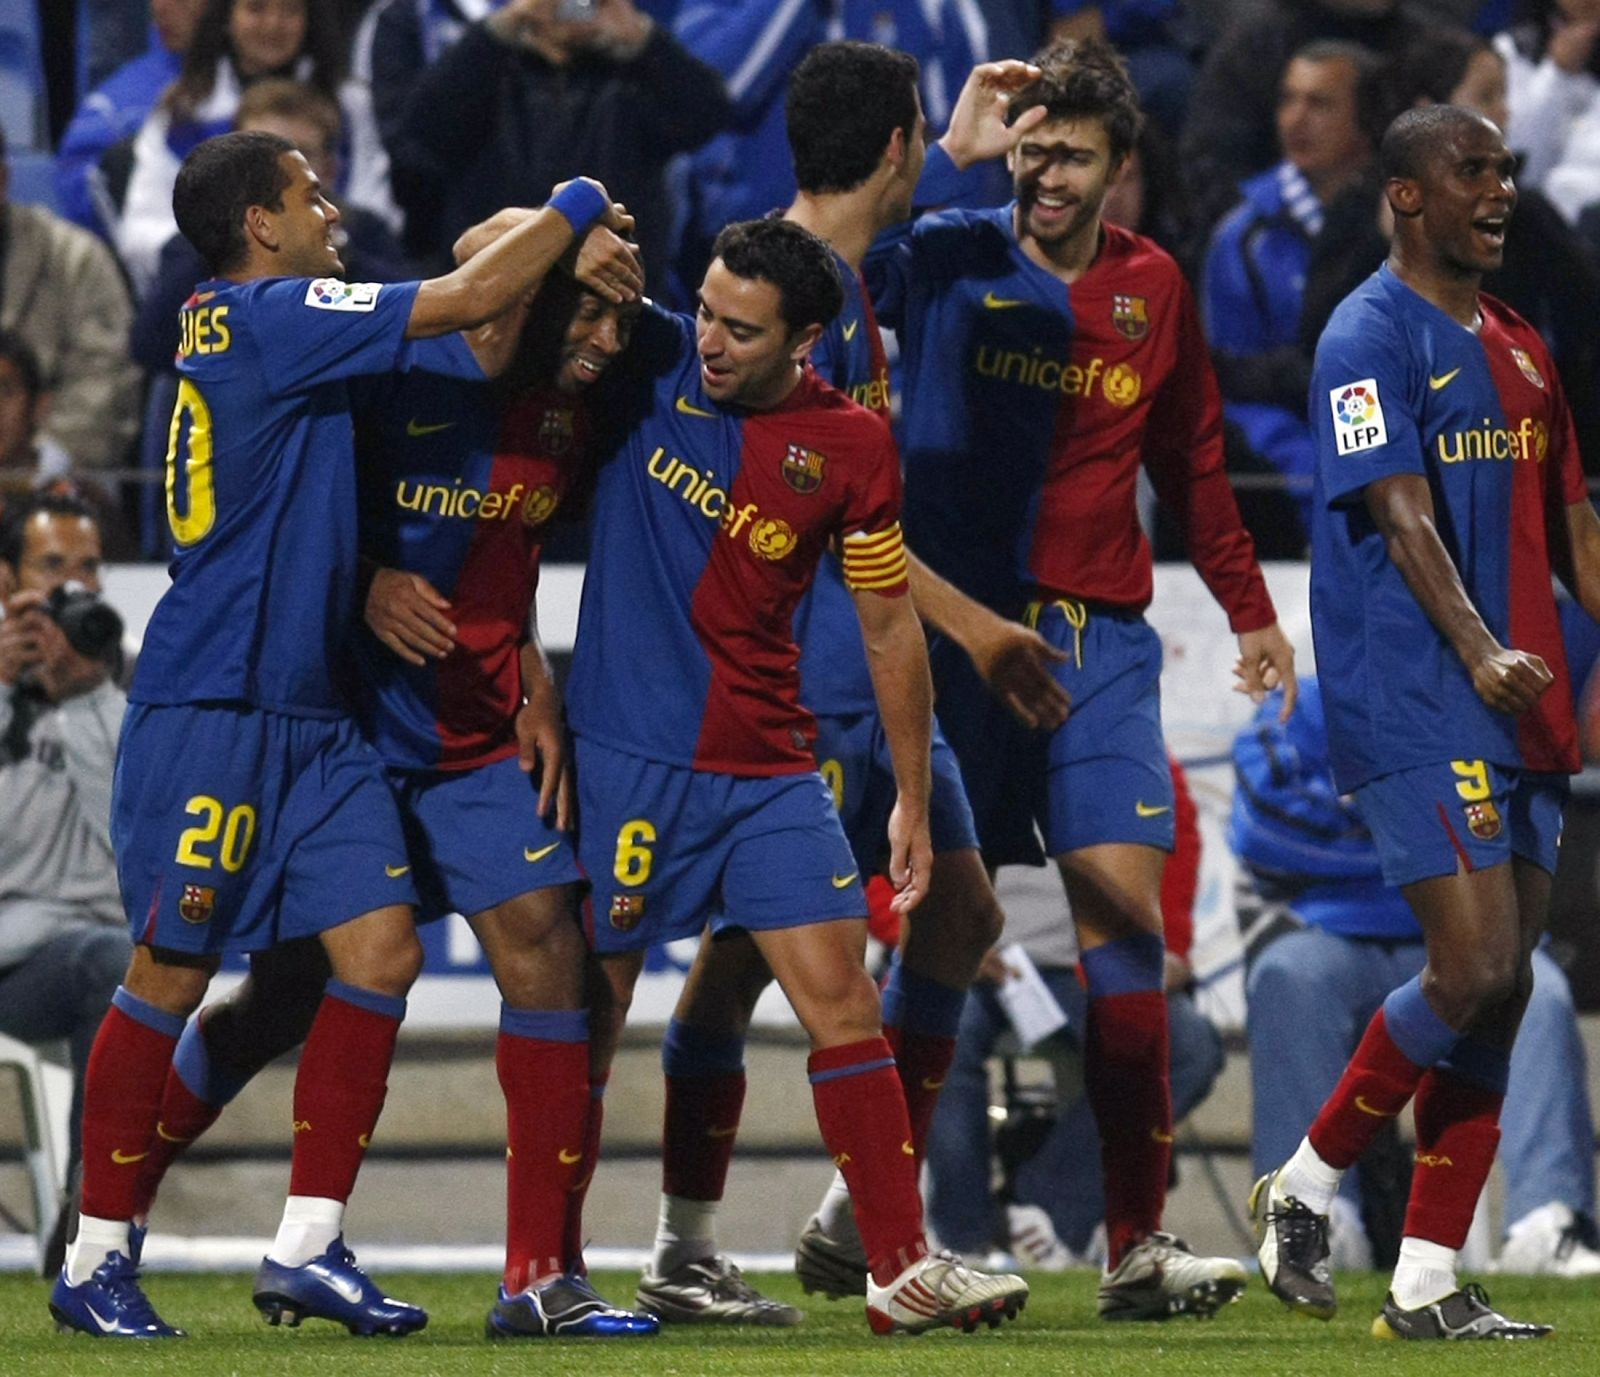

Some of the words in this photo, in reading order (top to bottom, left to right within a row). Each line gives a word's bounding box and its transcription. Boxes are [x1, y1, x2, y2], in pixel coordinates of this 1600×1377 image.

[975, 346, 1103, 397] unicef
[1342, 425, 1379, 450] LFP
[1438, 417, 1533, 463] unicef
[396, 477, 524, 521] unicef
[647, 446, 758, 538] unicef
[175, 794, 256, 872] 20
[613, 819, 657, 887] 6
